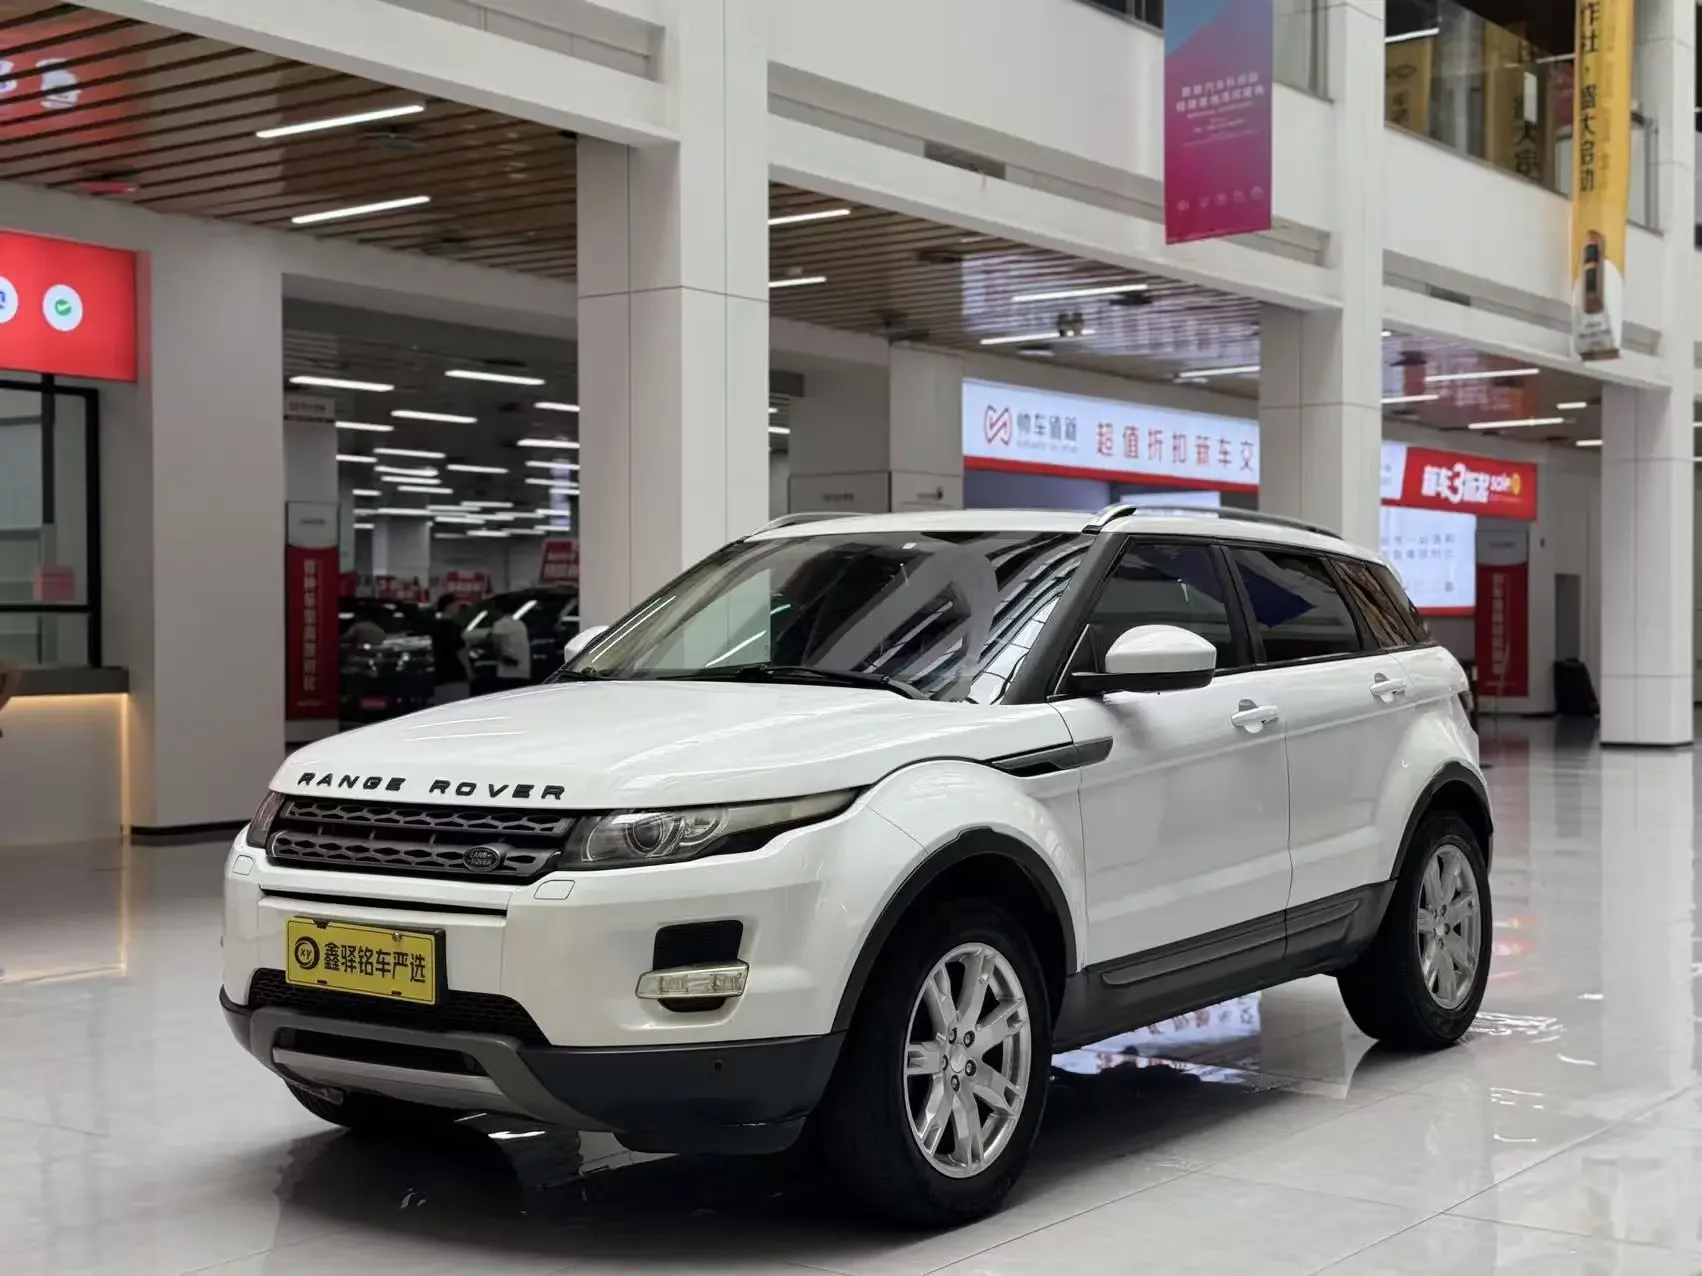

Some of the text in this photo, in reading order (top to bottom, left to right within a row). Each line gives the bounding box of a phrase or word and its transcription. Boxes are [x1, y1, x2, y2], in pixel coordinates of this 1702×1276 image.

[1096, 421, 1255, 473] 超值折扣新车交
[297, 772, 566, 801] RANGE ROVER
[469, 851, 488, 859] LAND
[469, 858, 492, 866] ROVER
[323, 941, 427, 984] 鑫驿铭车严选
